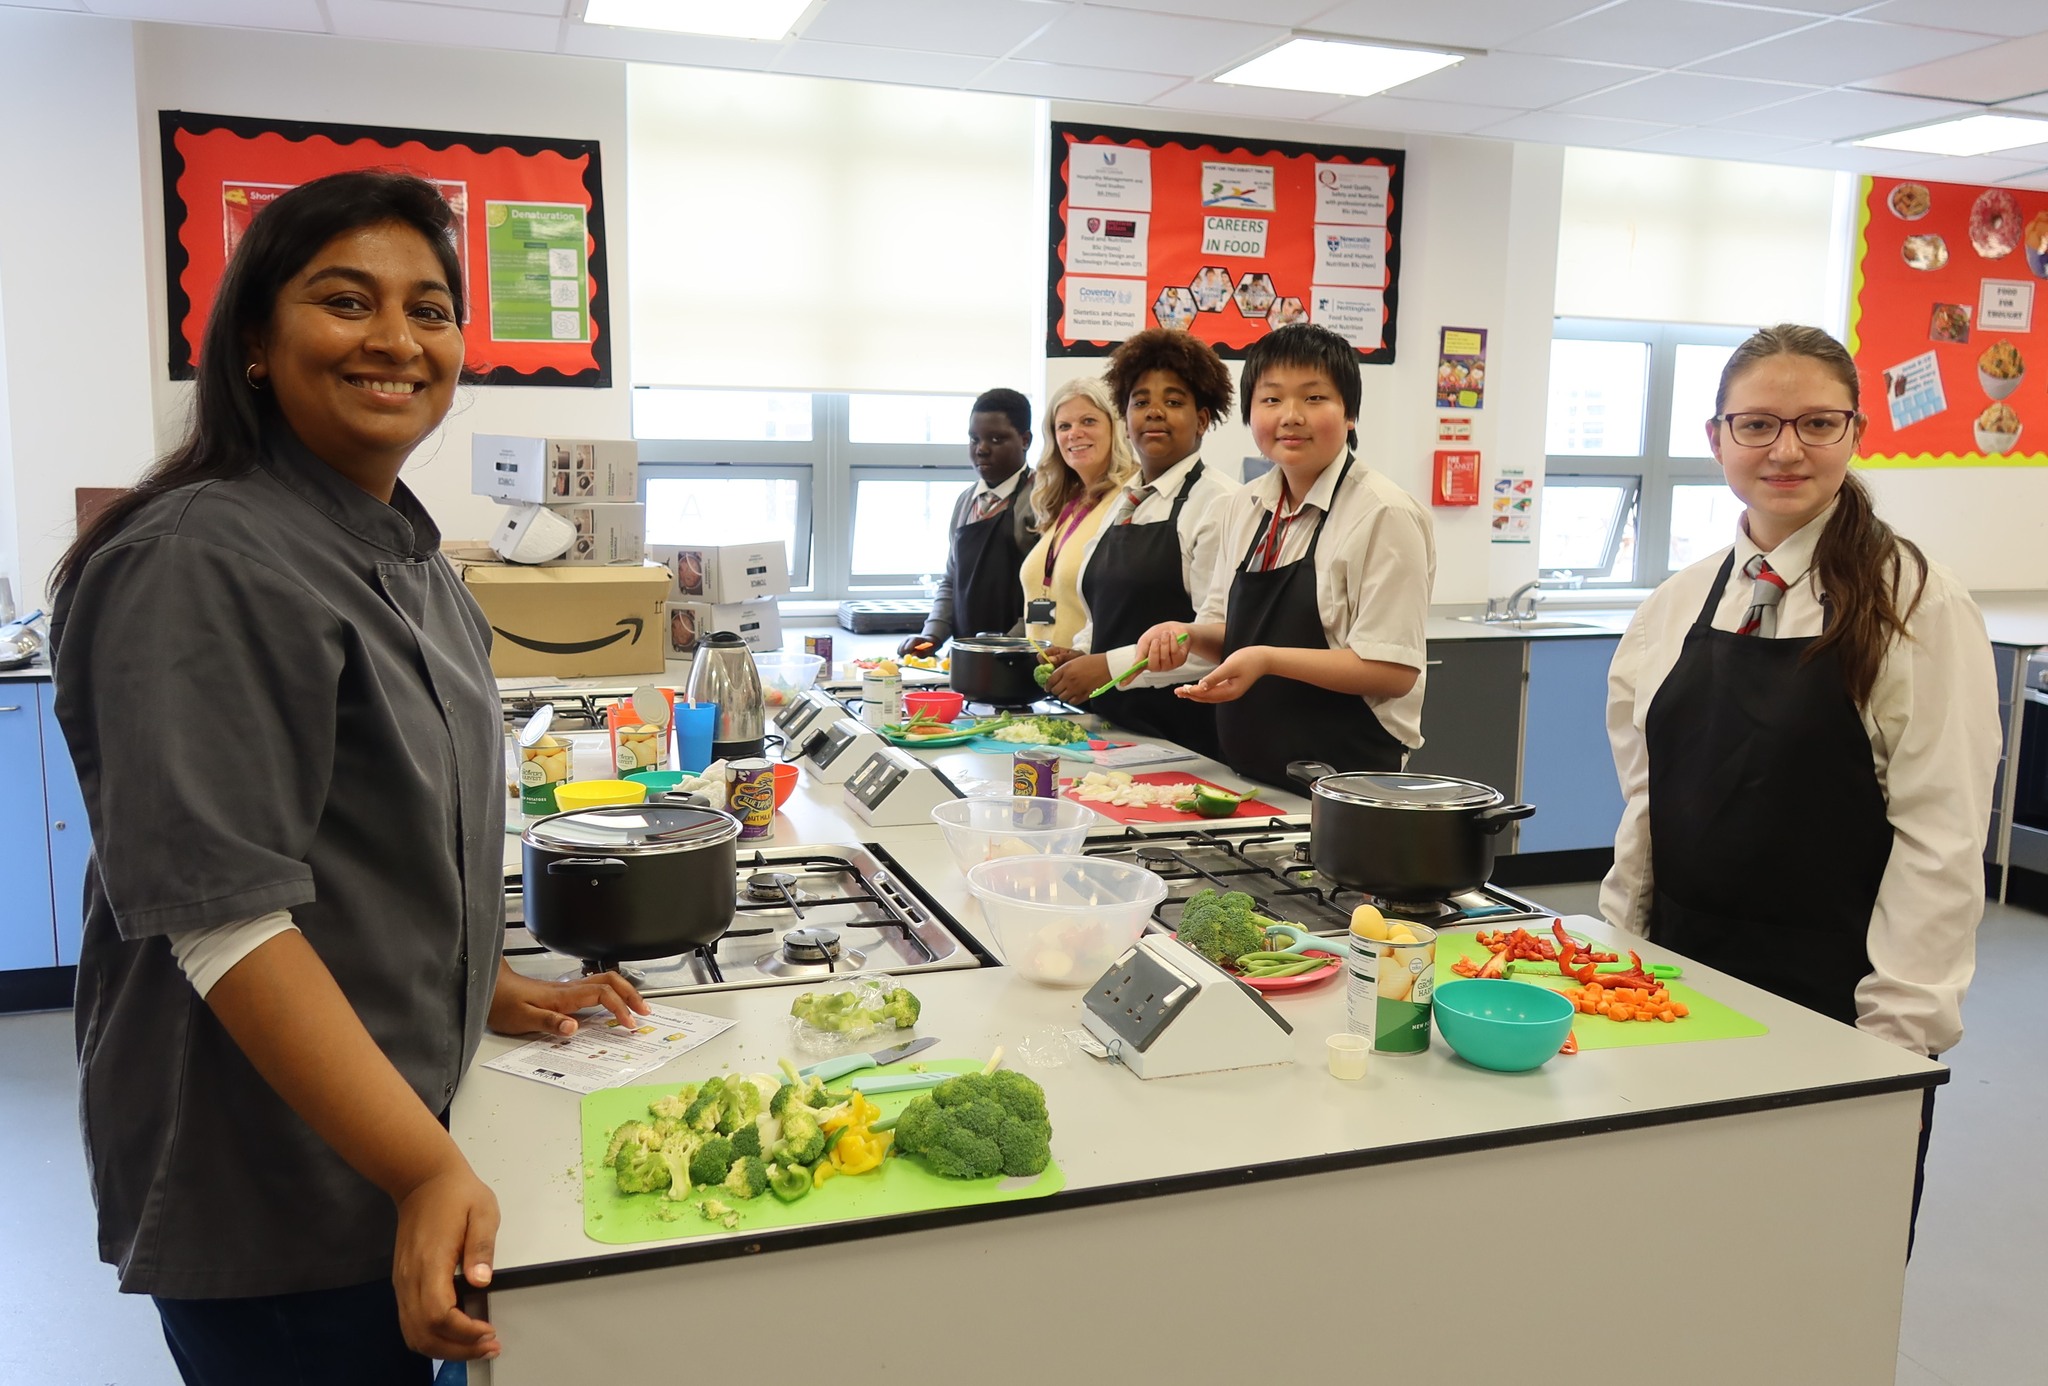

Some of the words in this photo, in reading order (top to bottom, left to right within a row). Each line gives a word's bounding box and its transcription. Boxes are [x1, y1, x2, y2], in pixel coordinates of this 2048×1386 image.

[512, 209, 576, 221] Denaturation
[1207, 217, 1264, 233] CAREERS
[1206, 238, 1220, 252] IN
[1224, 240, 1260, 254] FOOD
[1074, 258, 1102, 266] Technology
[1080, 287, 1117, 298] Coventry
[1997, 287, 2018, 296] FOOD
[1080, 295, 1116, 305] University
[1998, 299, 2014, 308] FOR
[1073, 308, 1100, 317] Dietetics
[1336, 304, 1376, 313] Nottingham
[1987, 310, 2022, 320] THOUGHT
